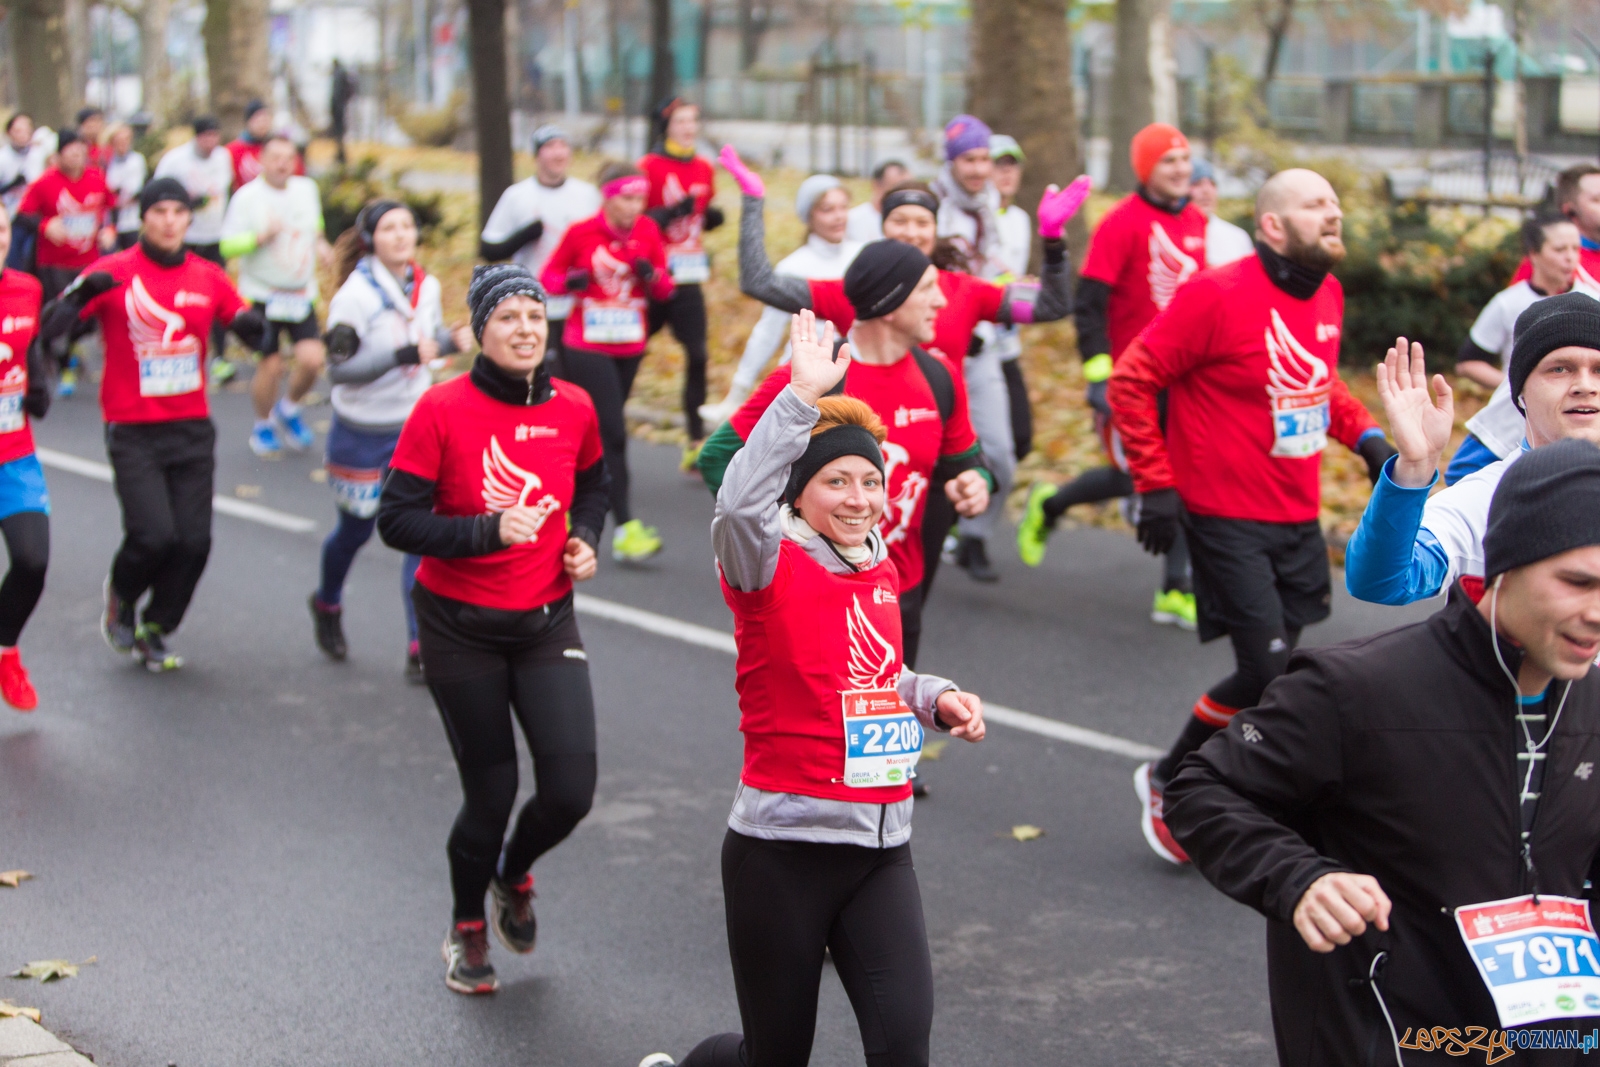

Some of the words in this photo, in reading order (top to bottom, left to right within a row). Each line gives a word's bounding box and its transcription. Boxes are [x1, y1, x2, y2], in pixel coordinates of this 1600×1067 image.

[850, 734, 859, 745] E
[862, 720, 920, 754] 2208
[1481, 956, 1499, 972] E
[1494, 935, 1600, 980] 7971
